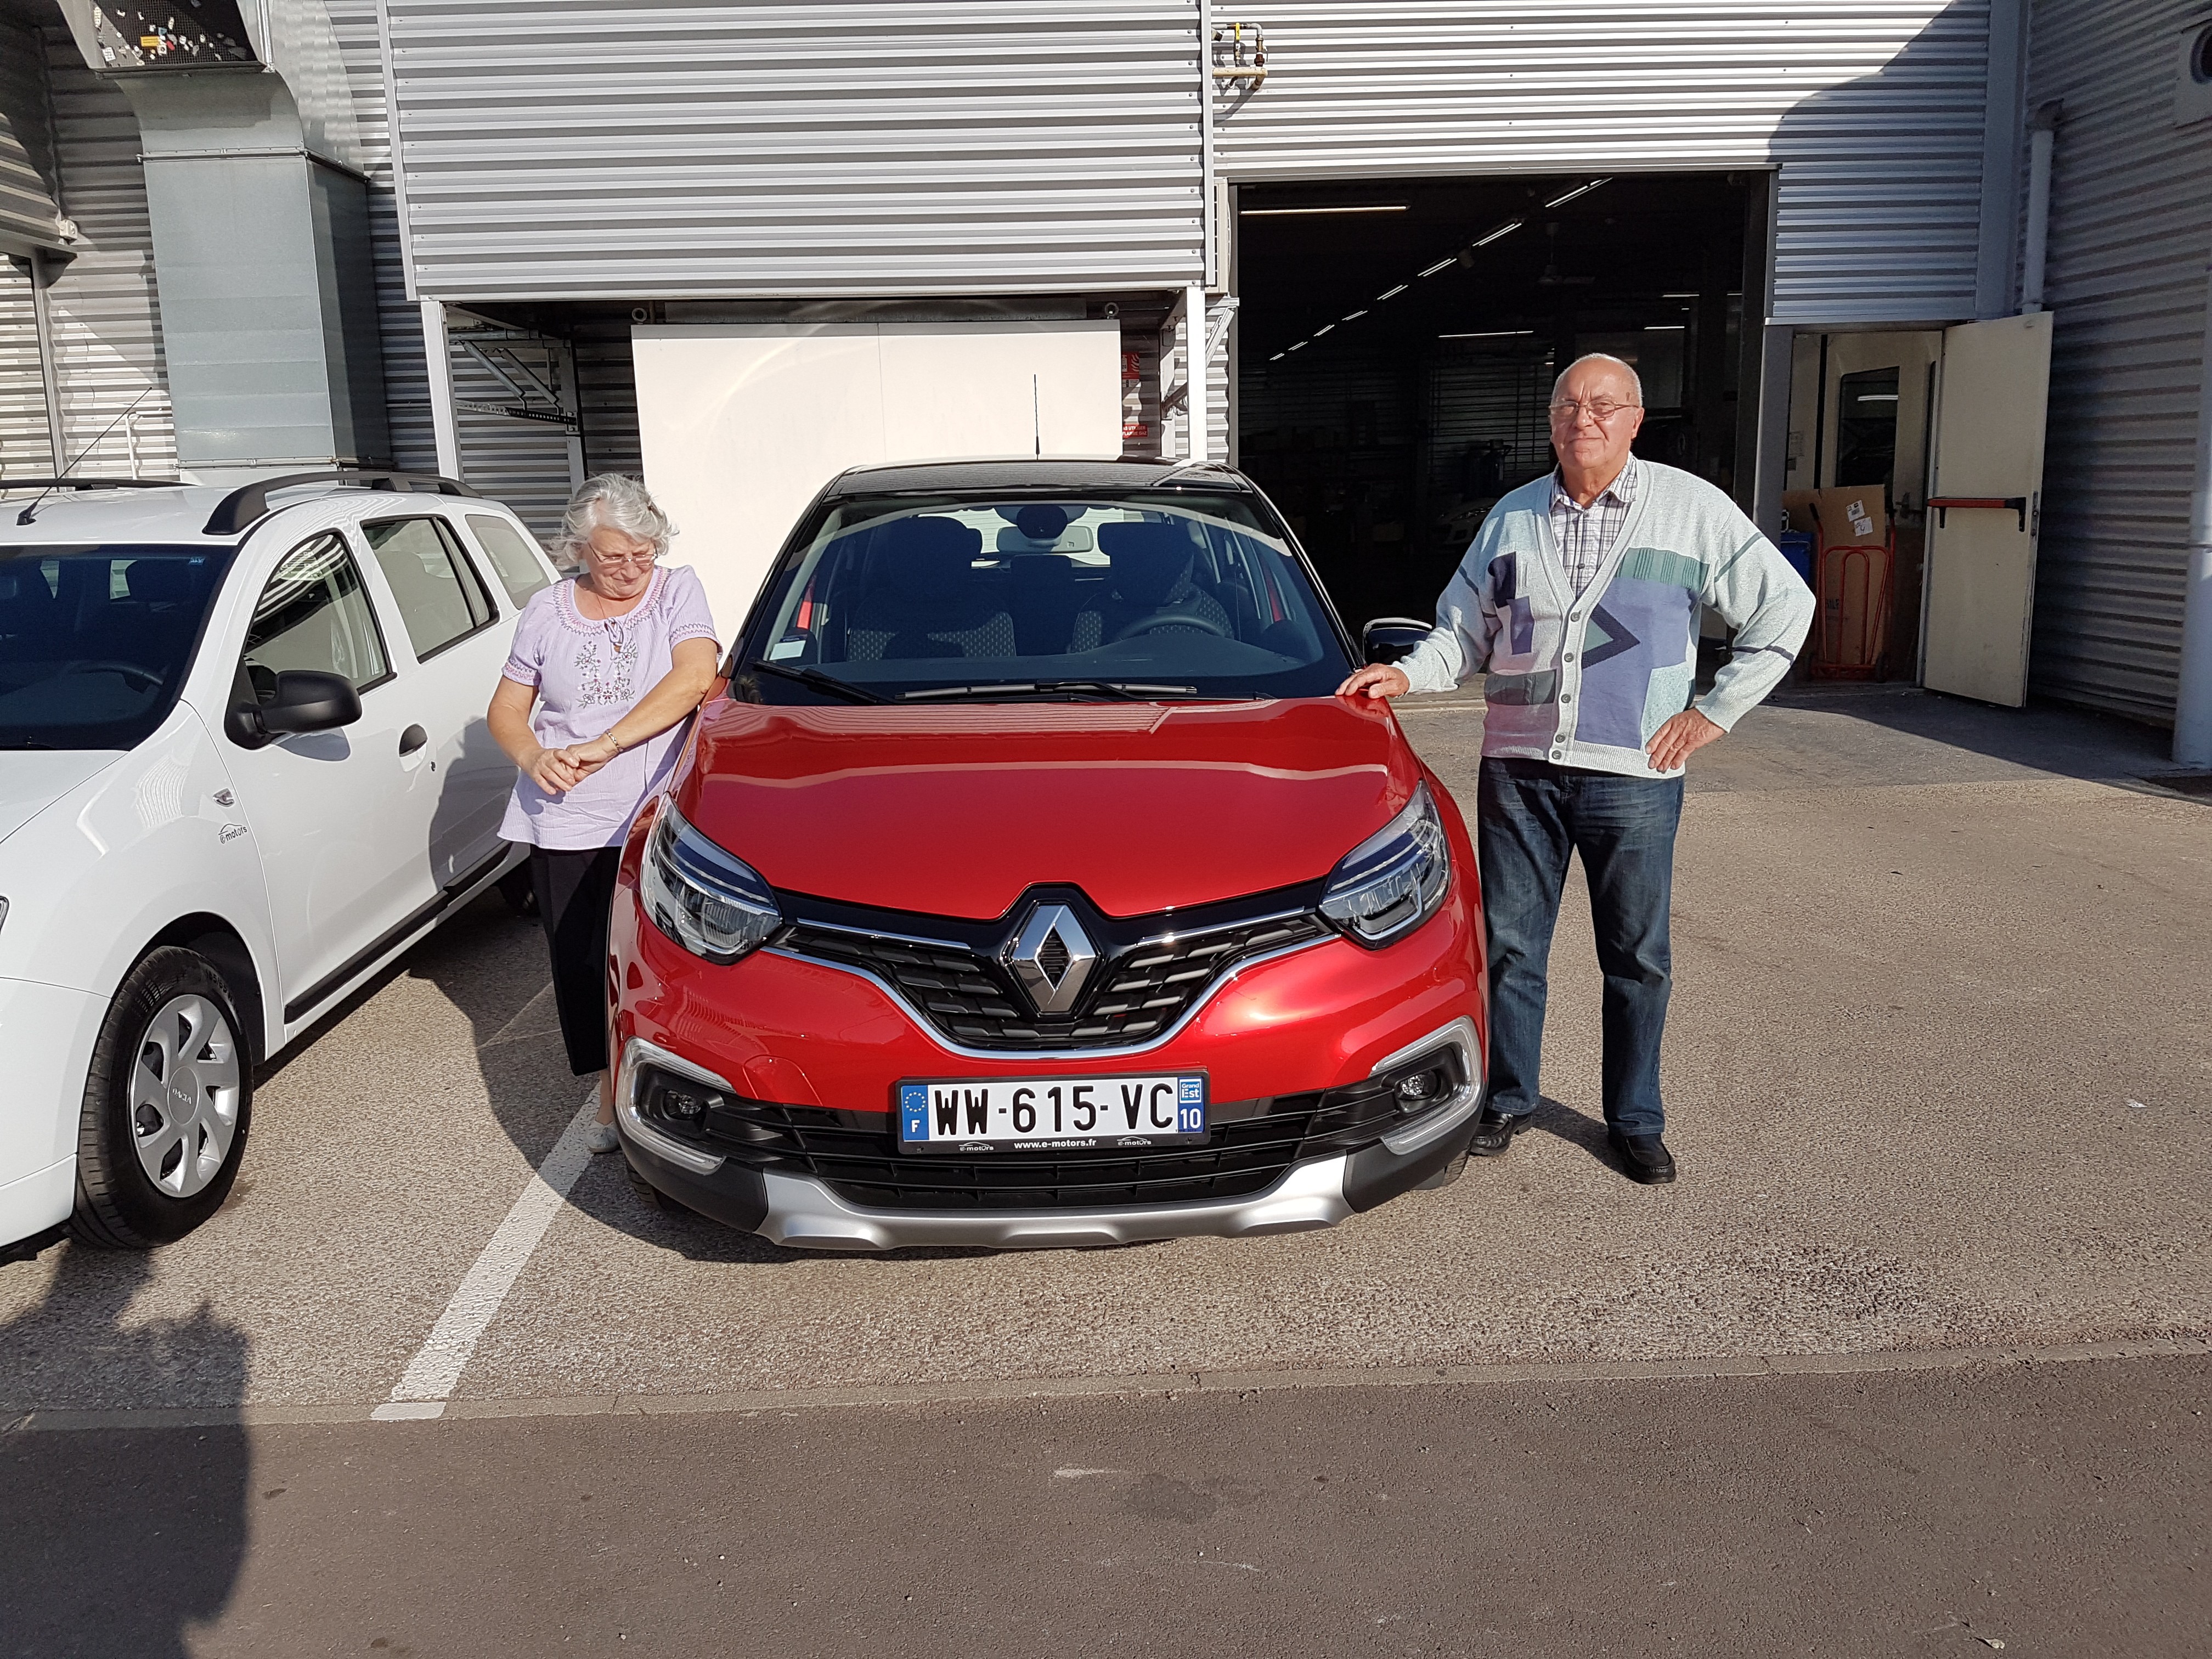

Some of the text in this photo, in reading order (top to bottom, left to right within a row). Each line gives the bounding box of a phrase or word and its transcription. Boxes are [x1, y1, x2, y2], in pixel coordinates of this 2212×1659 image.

[1181, 1088, 1199, 1098] Est
[934, 1083, 1173, 1135] WW-615-VC
[1180, 1108, 1201, 1129] 10
[911, 1120, 920, 1133] F
[1014, 1138, 1097, 1149] www.e-motors.fr
